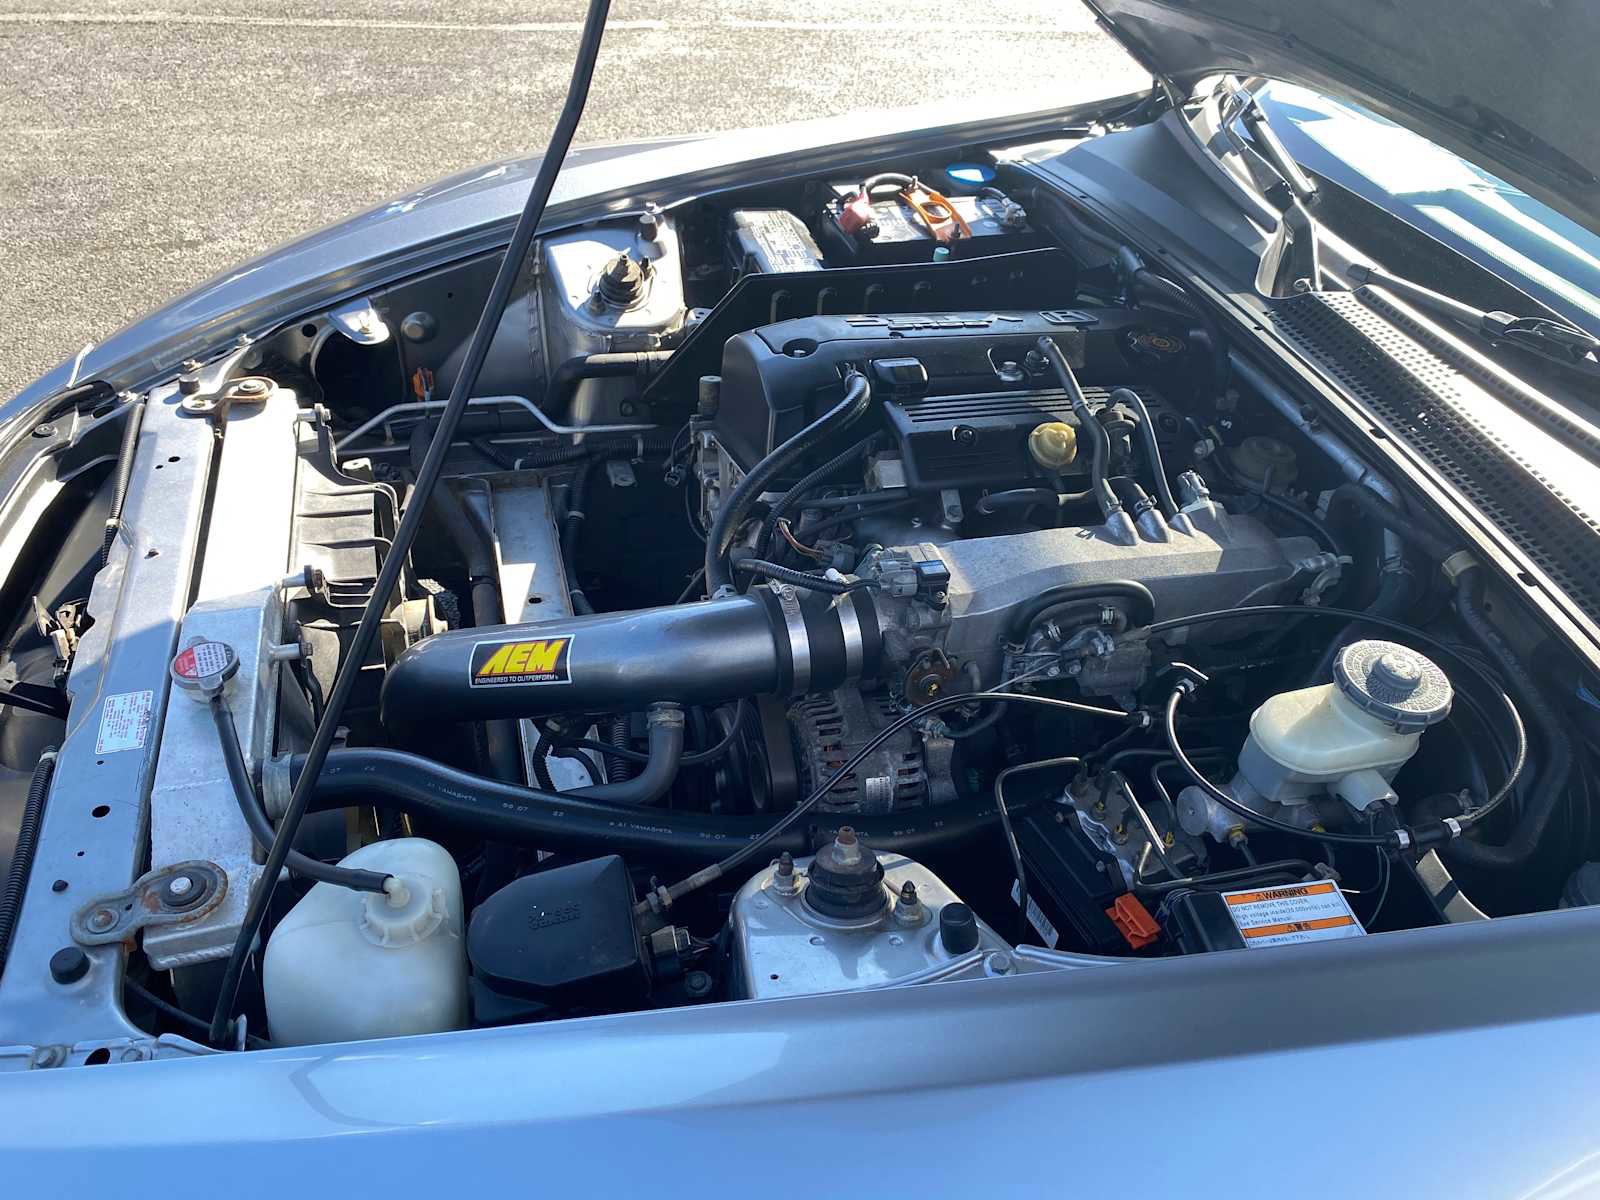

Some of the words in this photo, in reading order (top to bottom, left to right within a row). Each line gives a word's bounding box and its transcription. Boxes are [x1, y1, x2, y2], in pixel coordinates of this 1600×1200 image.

[477, 638, 566, 676] AEM
[475, 675, 508, 684] ENGINEERED
[518, 674, 554, 682] OUTPERFORM
[1264, 887, 1308, 900] WARNING
